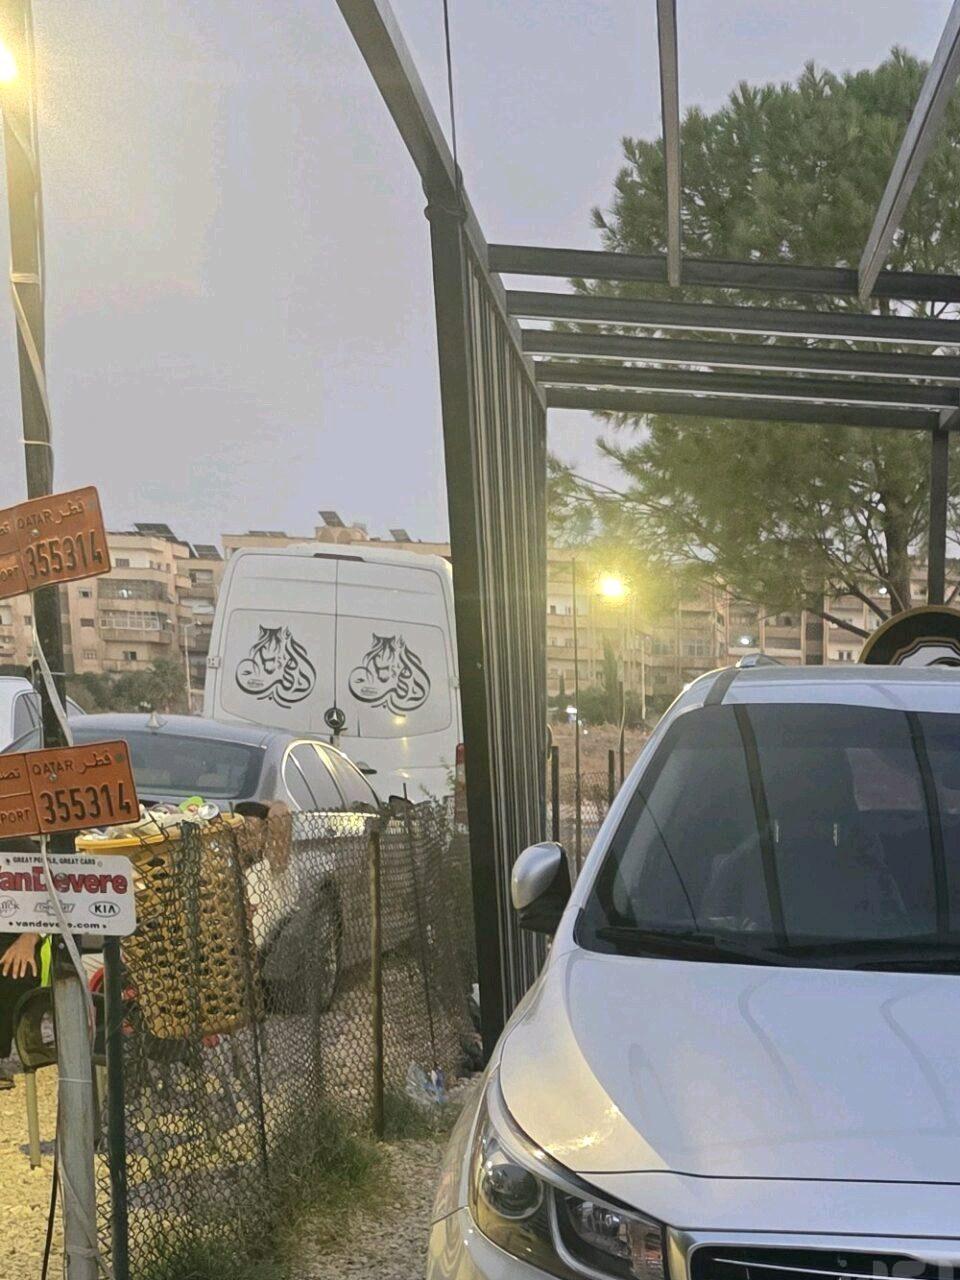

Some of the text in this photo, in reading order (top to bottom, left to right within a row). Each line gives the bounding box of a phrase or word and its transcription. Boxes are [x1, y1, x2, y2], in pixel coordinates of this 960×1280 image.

[17, 509, 53, 529] QATAR
[54, 498, 84, 524] قطر
[26, 529, 103, 579] 355314
[32, 759, 74, 776] QATAR
[80, 750, 112, 774] قطر
[39, 780, 132, 825] 355314
[0, 808, 31, 824] PORT
[12, 856, 33, 864] GREAT
[0, 866, 128, 894] anDevere
[94, 904, 117, 914] KIA
